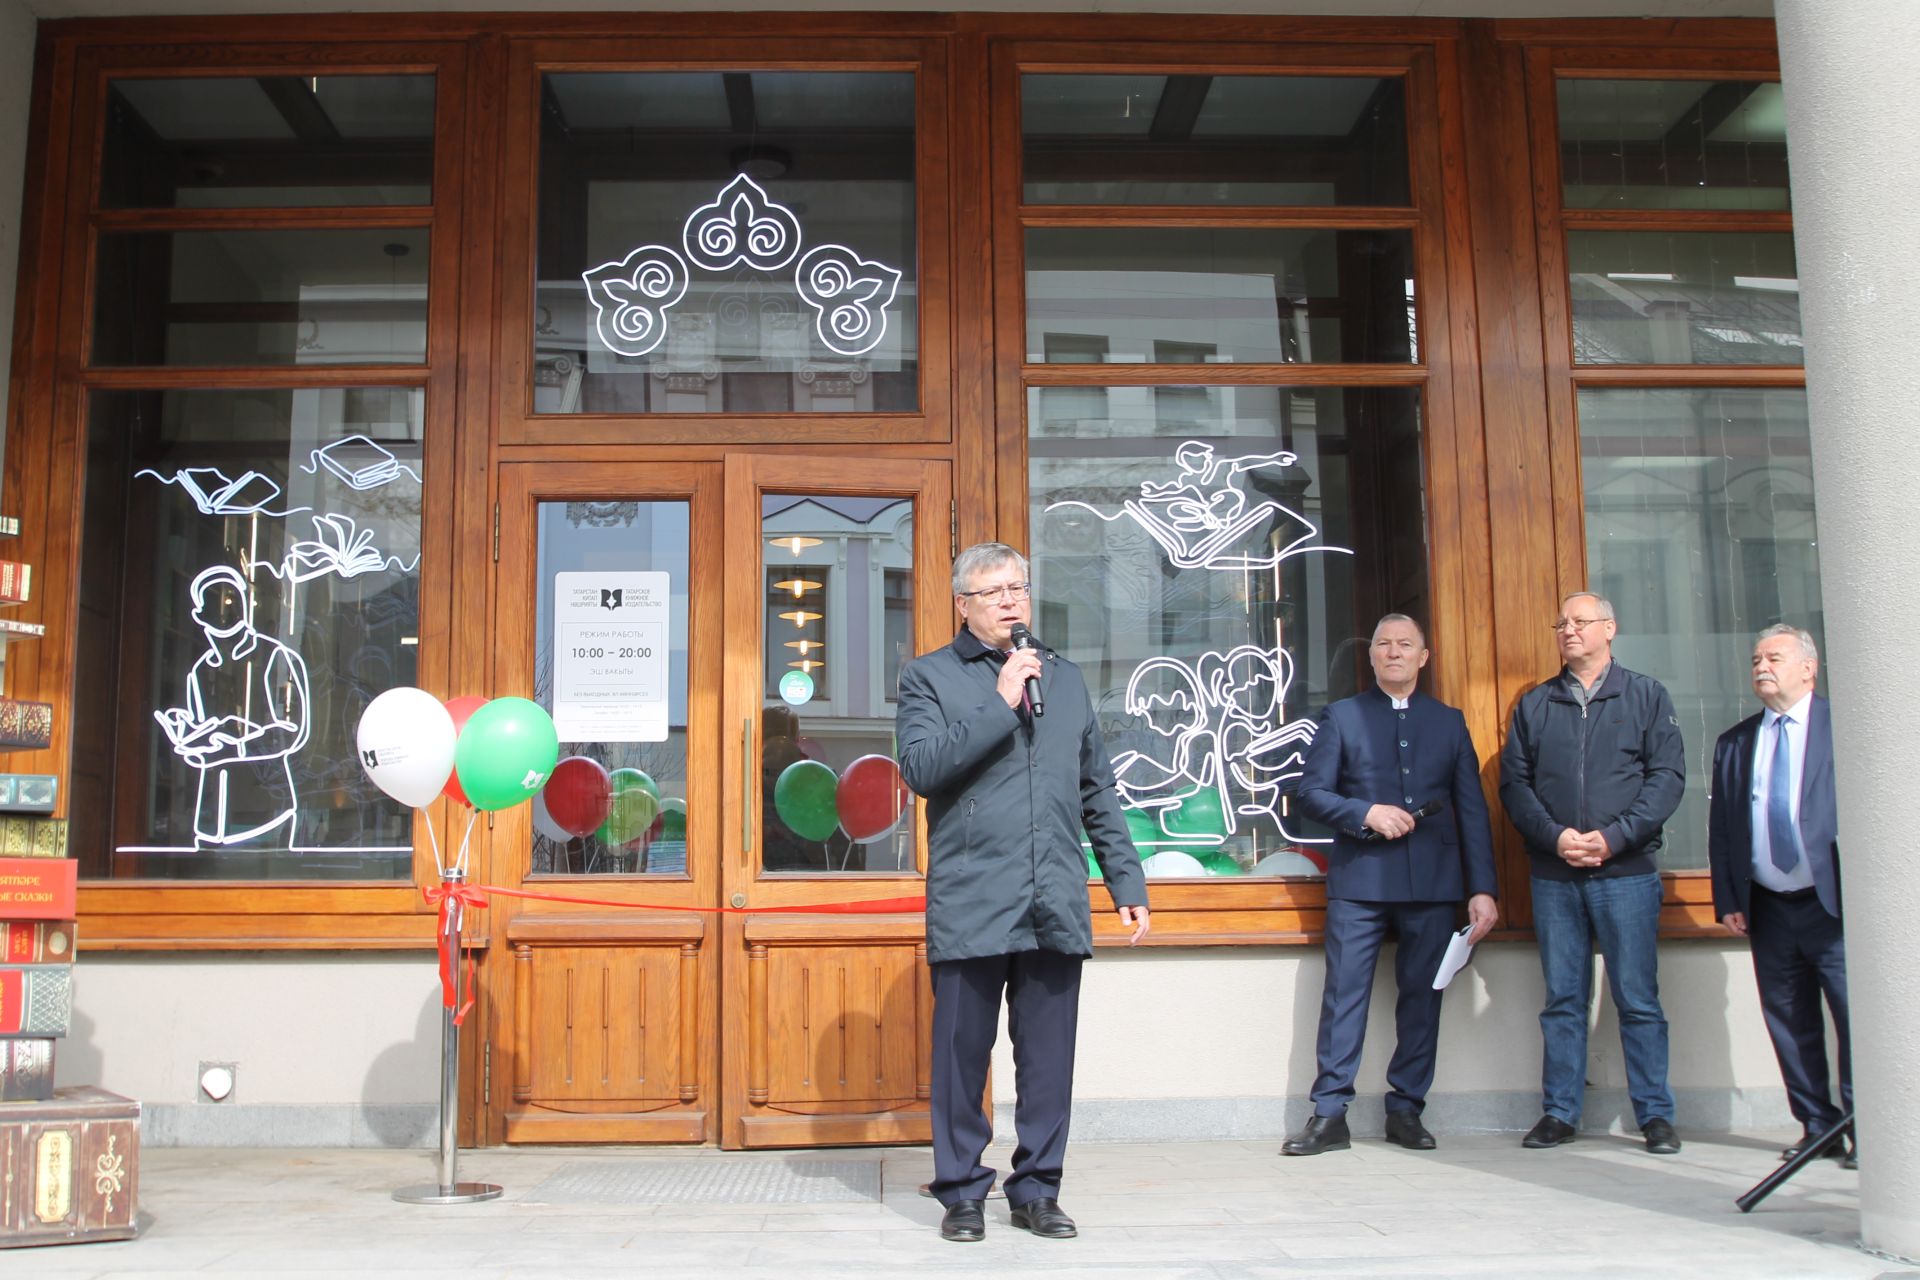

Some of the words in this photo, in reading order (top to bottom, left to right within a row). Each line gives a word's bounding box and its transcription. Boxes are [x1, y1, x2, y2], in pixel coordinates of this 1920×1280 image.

[572, 648, 604, 658] 10:00
[619, 648, 652, 658] 20:00
[15, 893, 53, 902] СКАЗКИ
